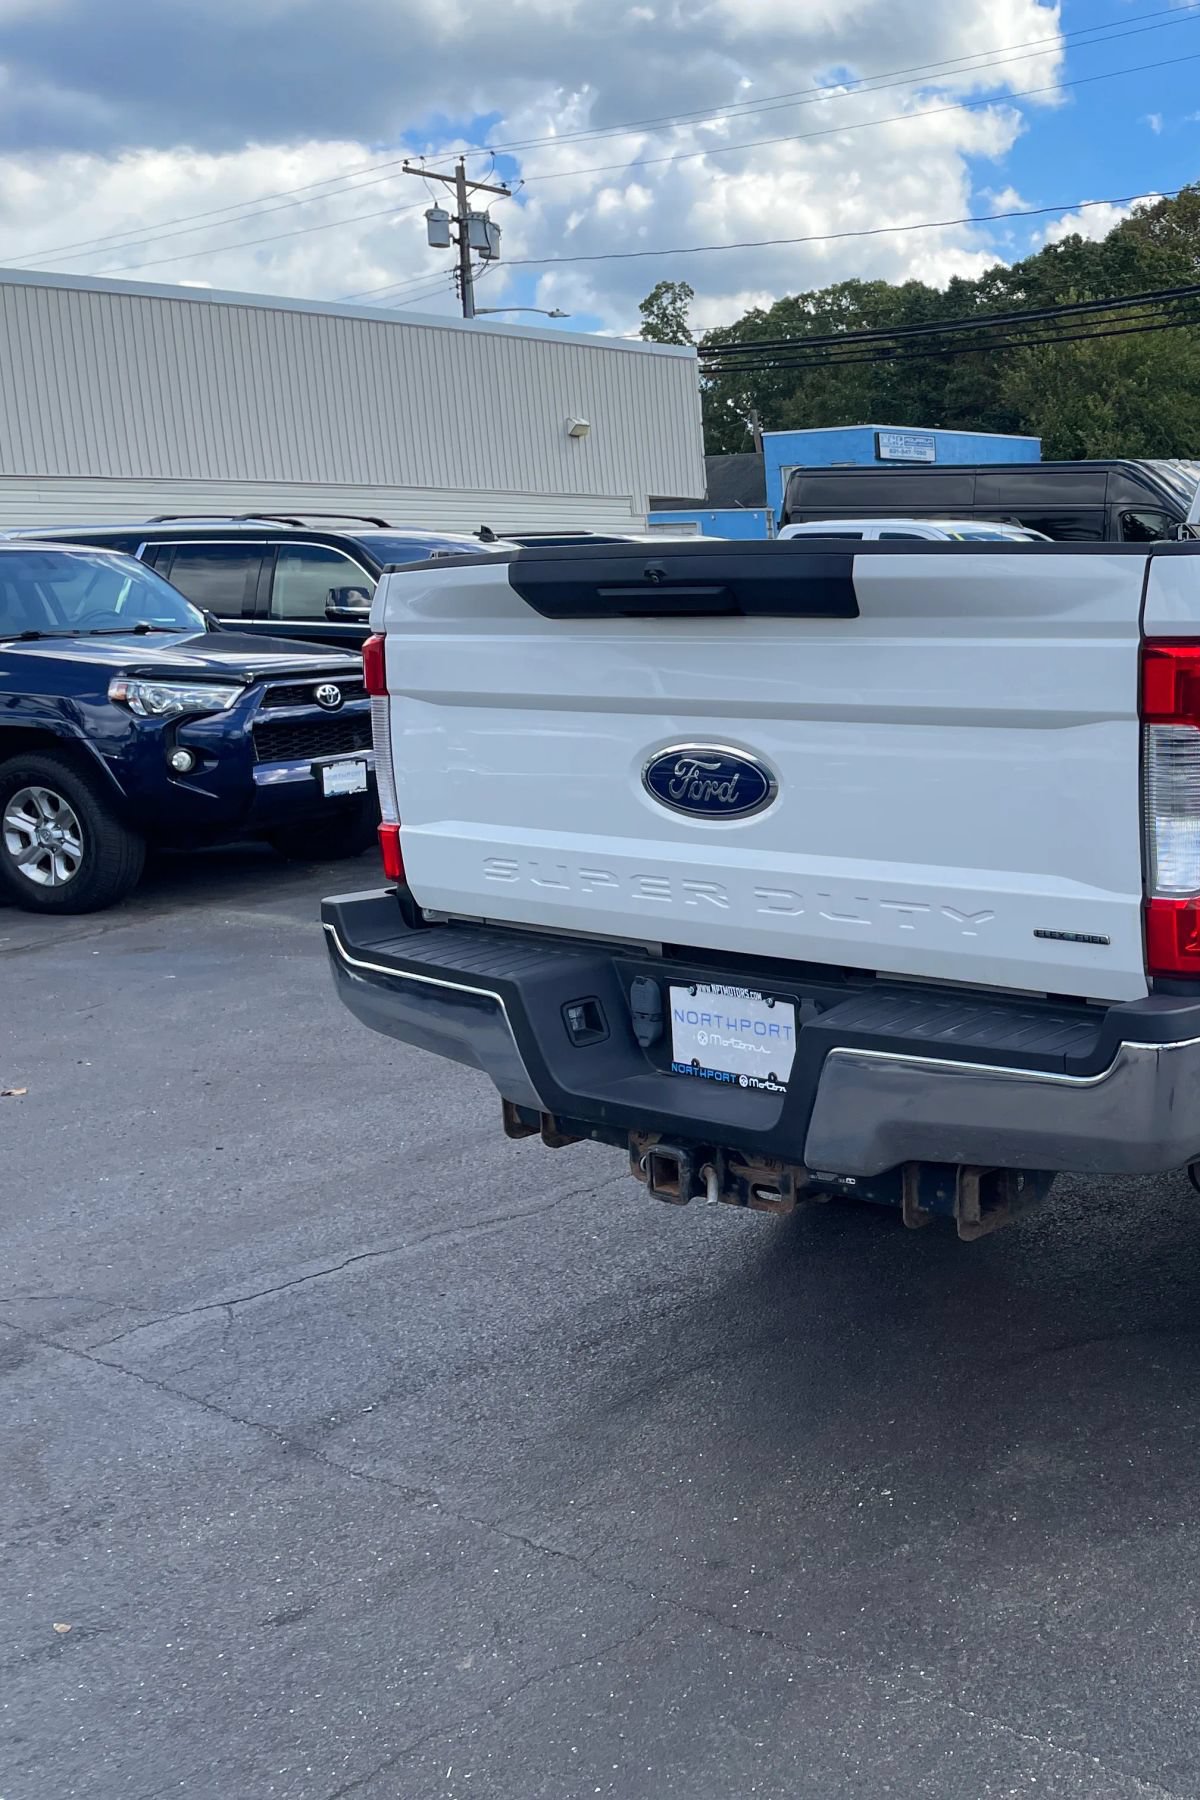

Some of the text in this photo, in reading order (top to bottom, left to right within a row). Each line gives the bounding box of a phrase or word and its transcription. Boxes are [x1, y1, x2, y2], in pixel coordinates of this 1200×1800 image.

[669, 758, 740, 803] Ford
[483, 857, 996, 936] SUPER DUTY
[1035, 929, 1066, 940] FLEX
[674, 1009, 793, 1040] NORTHPORT
[671, 1063, 737, 1083] NORTHPORT
